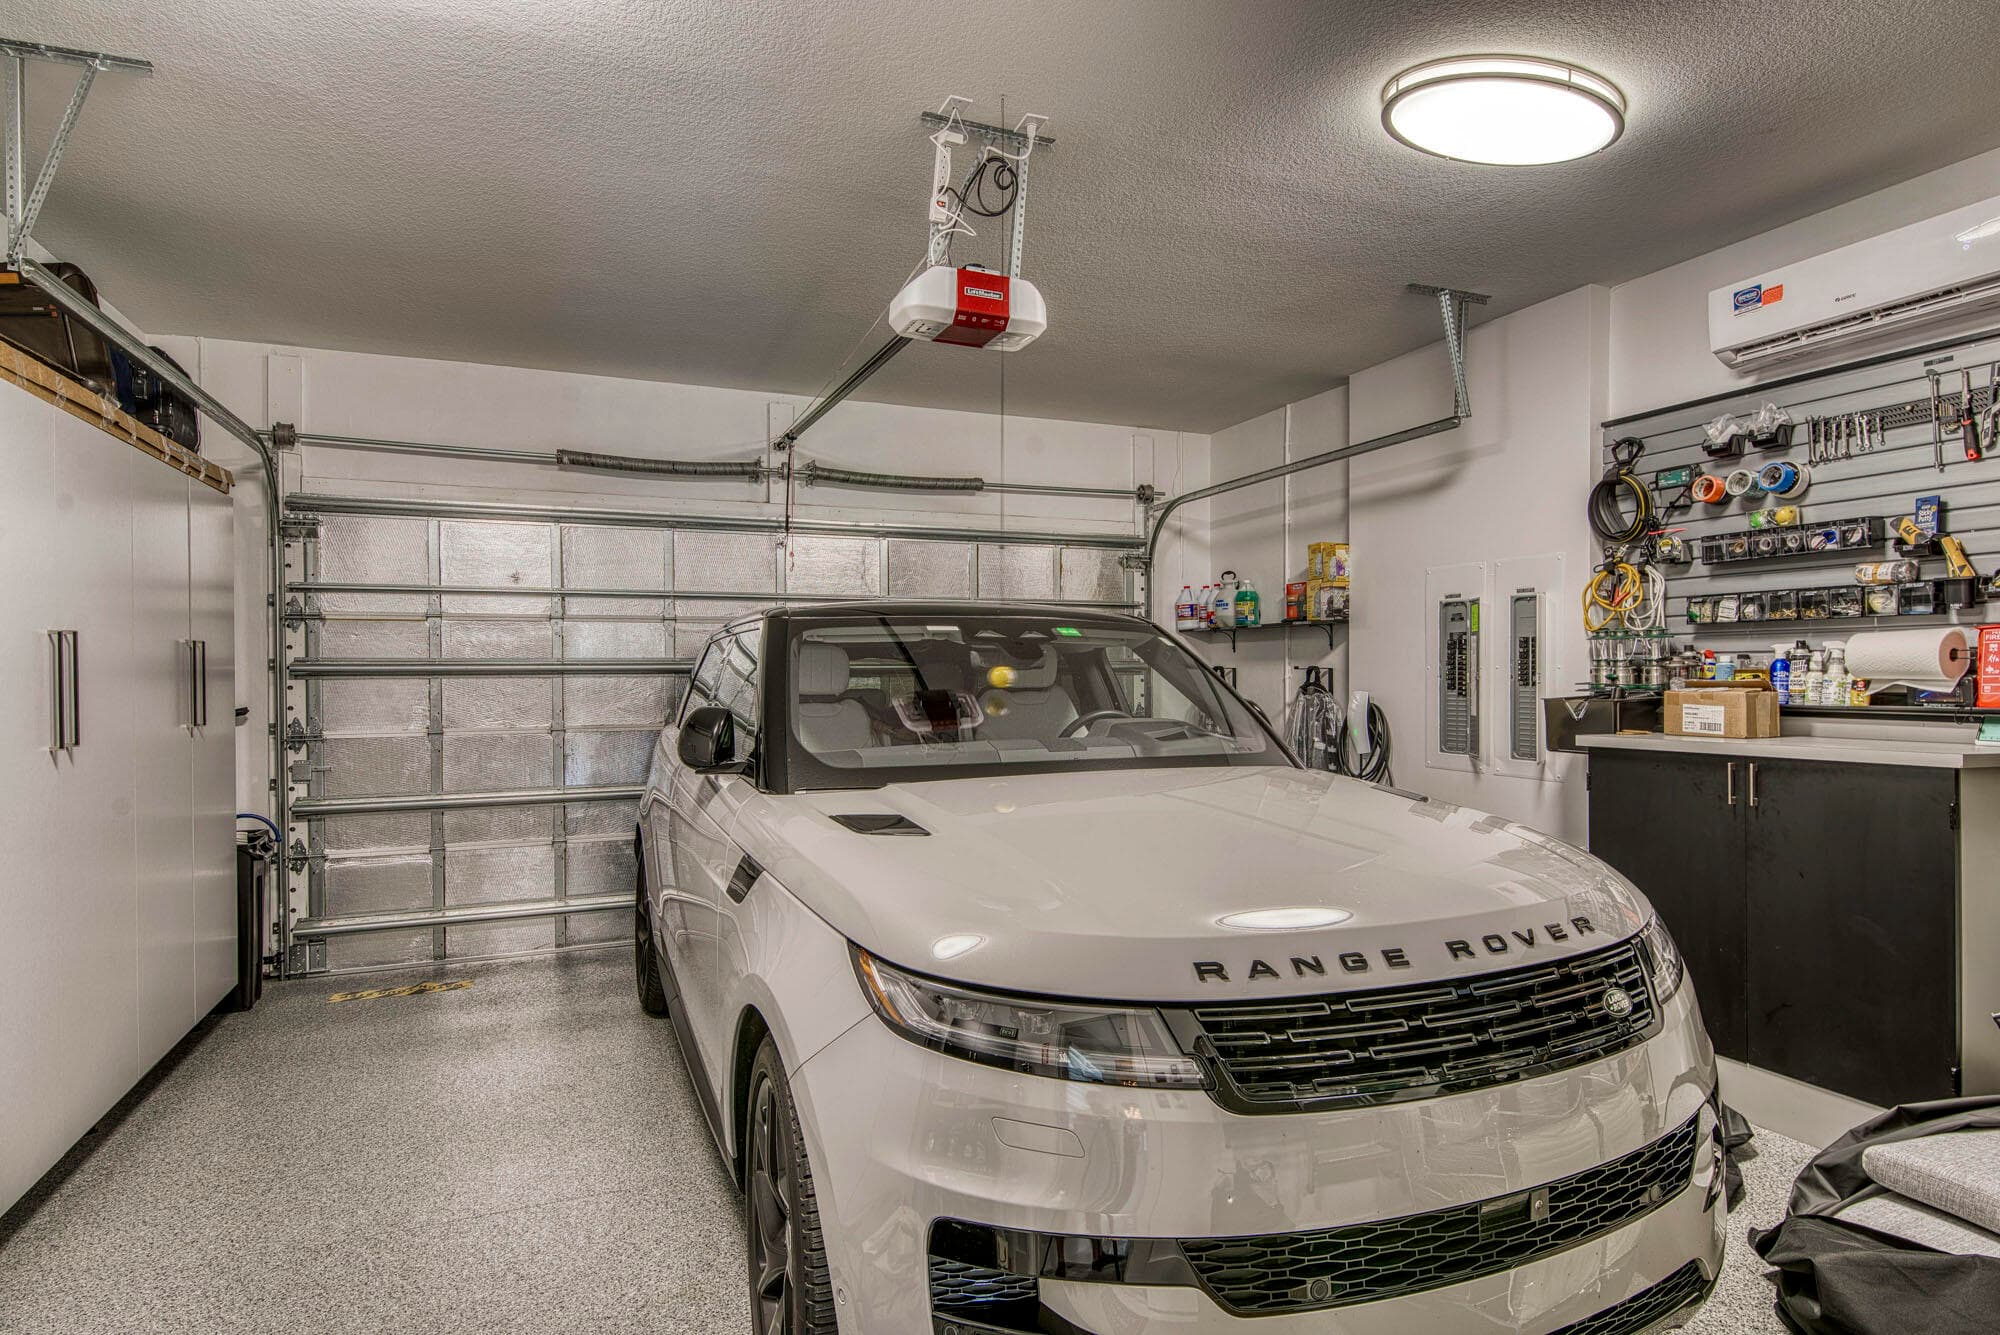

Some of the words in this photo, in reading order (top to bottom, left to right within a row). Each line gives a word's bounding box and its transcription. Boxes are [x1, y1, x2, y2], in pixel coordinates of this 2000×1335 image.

[1193, 948, 1410, 982] RANGE
[1445, 916, 1596, 961] ROVER
[1607, 993, 1625, 1004] LAND
[1612, 999, 1629, 1012] ROVER
